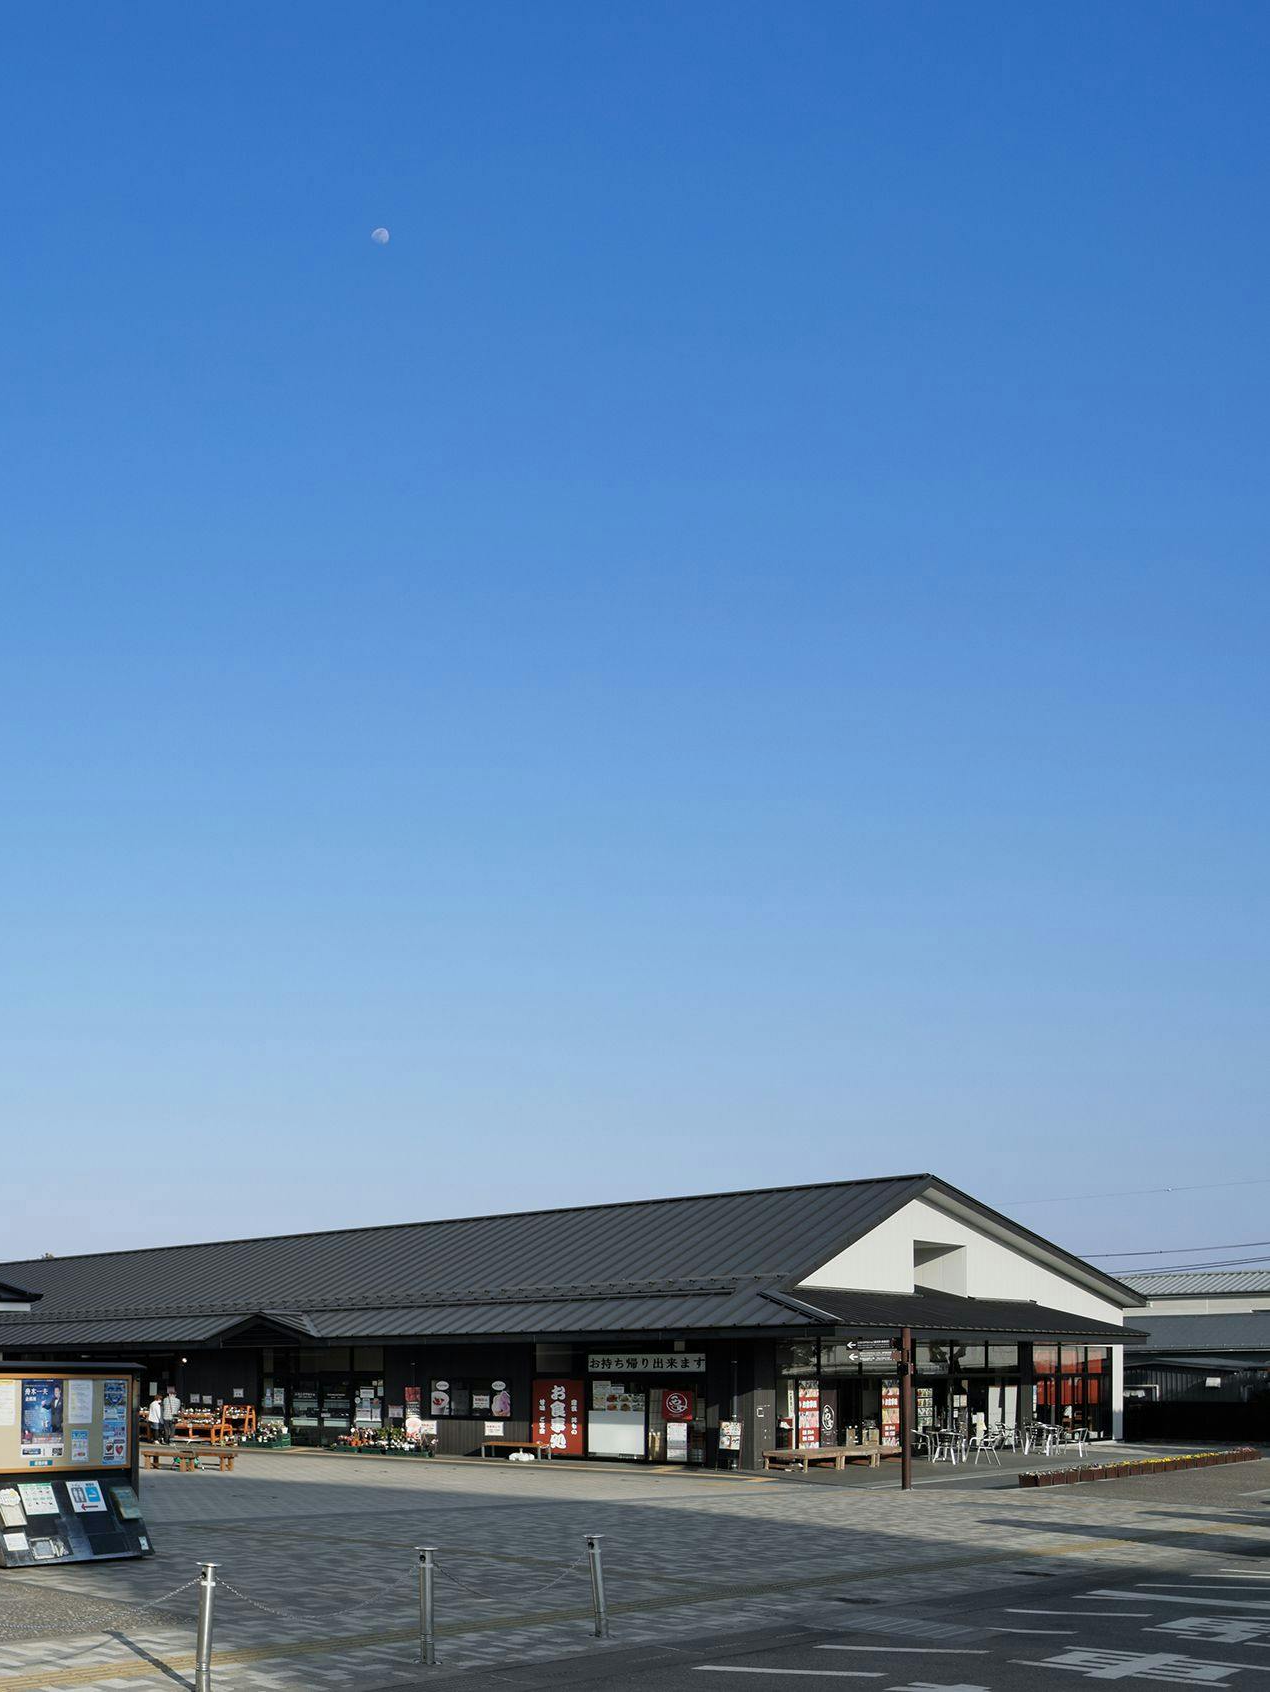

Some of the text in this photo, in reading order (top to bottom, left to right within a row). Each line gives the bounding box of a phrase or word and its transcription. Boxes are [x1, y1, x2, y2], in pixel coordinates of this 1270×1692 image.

[589, 1356, 706, 1370] お持ち帰り出来ます
[550, 1384, 567, 1449] お食事処
